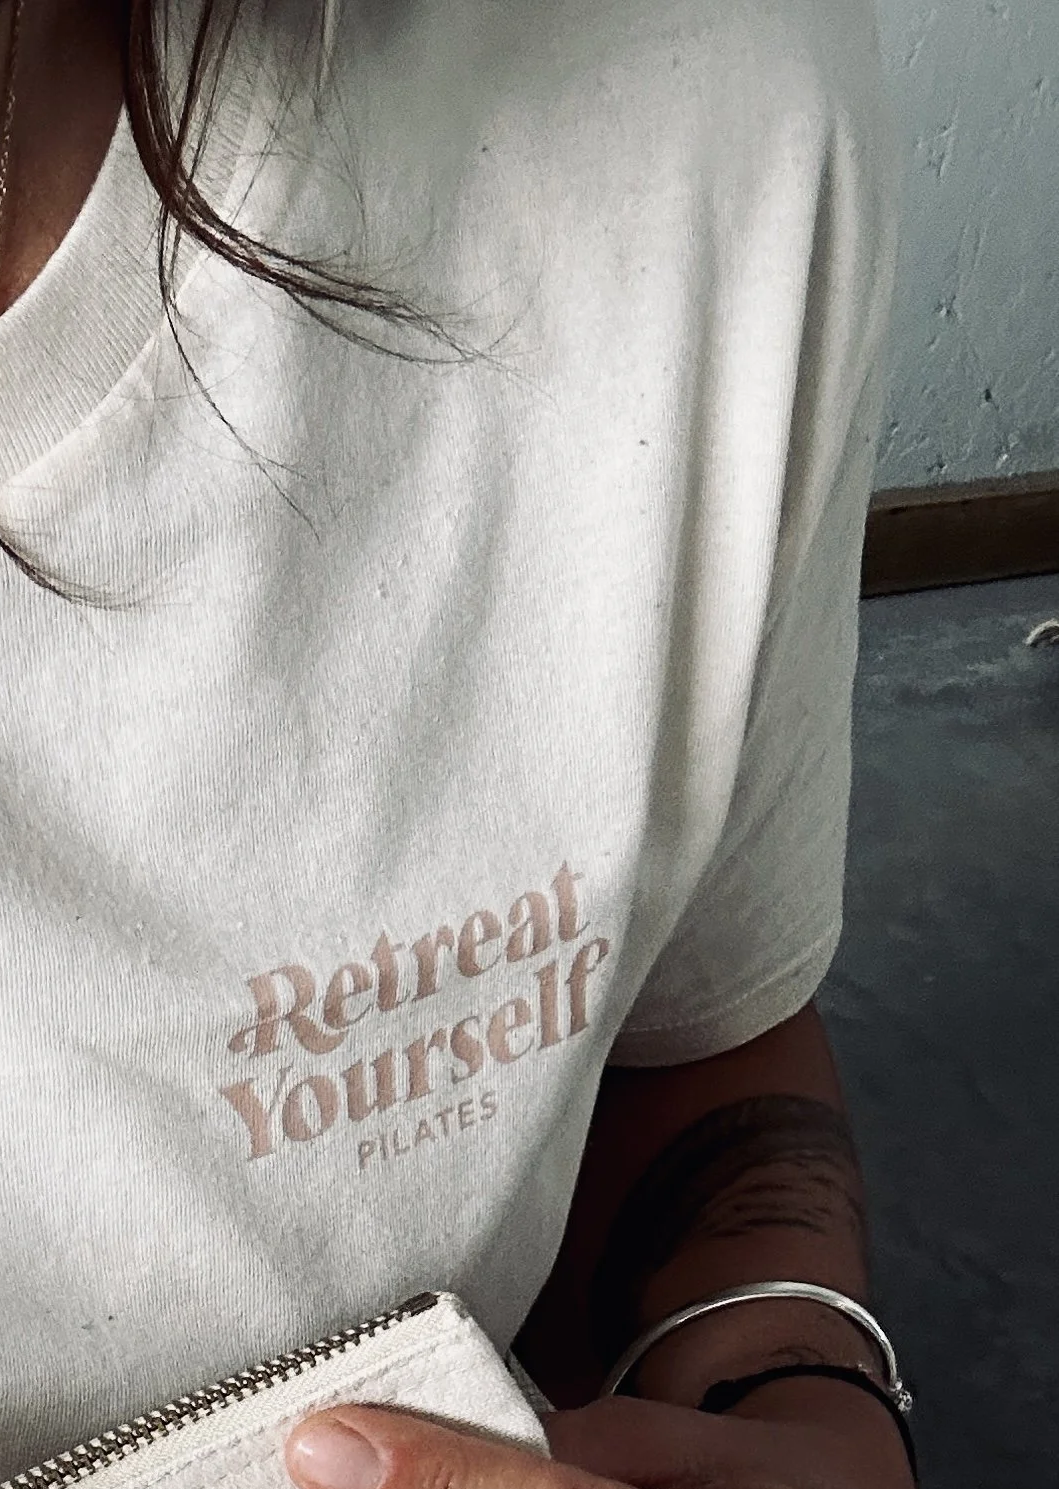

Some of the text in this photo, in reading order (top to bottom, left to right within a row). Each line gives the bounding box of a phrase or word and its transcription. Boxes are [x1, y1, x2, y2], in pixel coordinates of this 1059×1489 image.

[219, 937, 610, 1161] Yourself
[227, 860, 590, 1060] Retreat
[357, 1090, 499, 1170] PILATES
